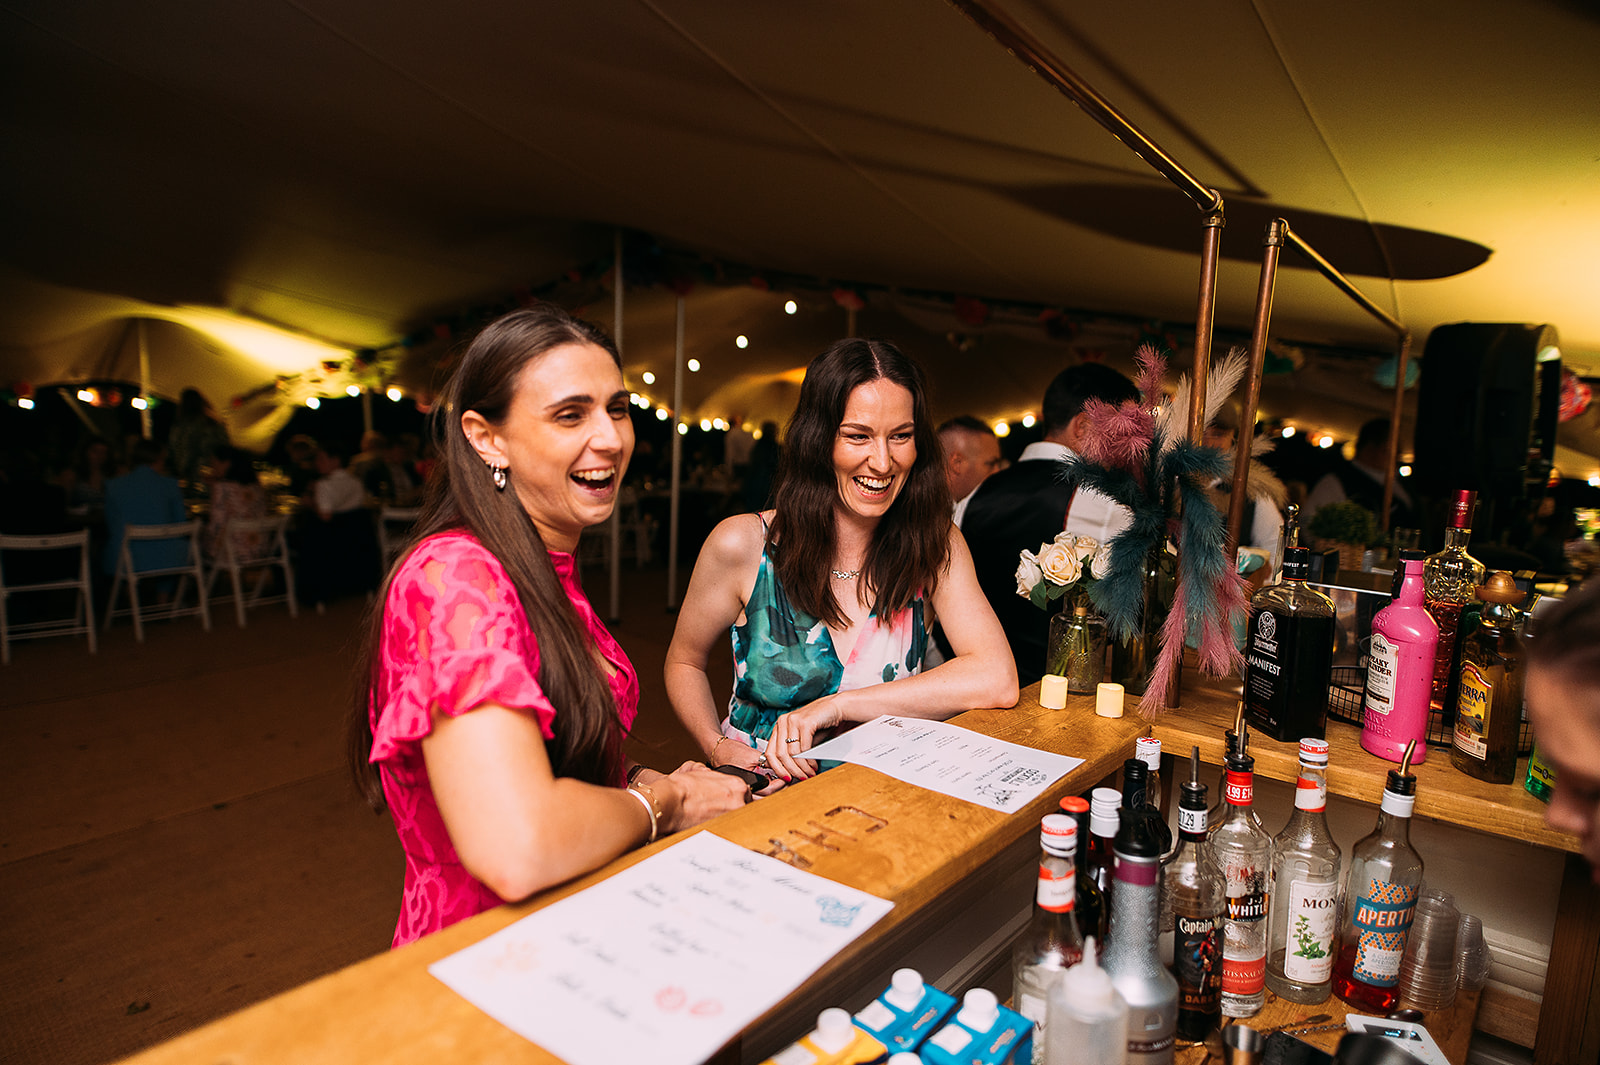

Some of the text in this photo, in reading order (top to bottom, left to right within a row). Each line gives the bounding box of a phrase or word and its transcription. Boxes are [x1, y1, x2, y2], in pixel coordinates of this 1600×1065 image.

[1248, 654, 1281, 676] MANIFEST
[1179, 917, 1212, 936] Captain
[1222, 968, 1256, 978] RTISANAL
